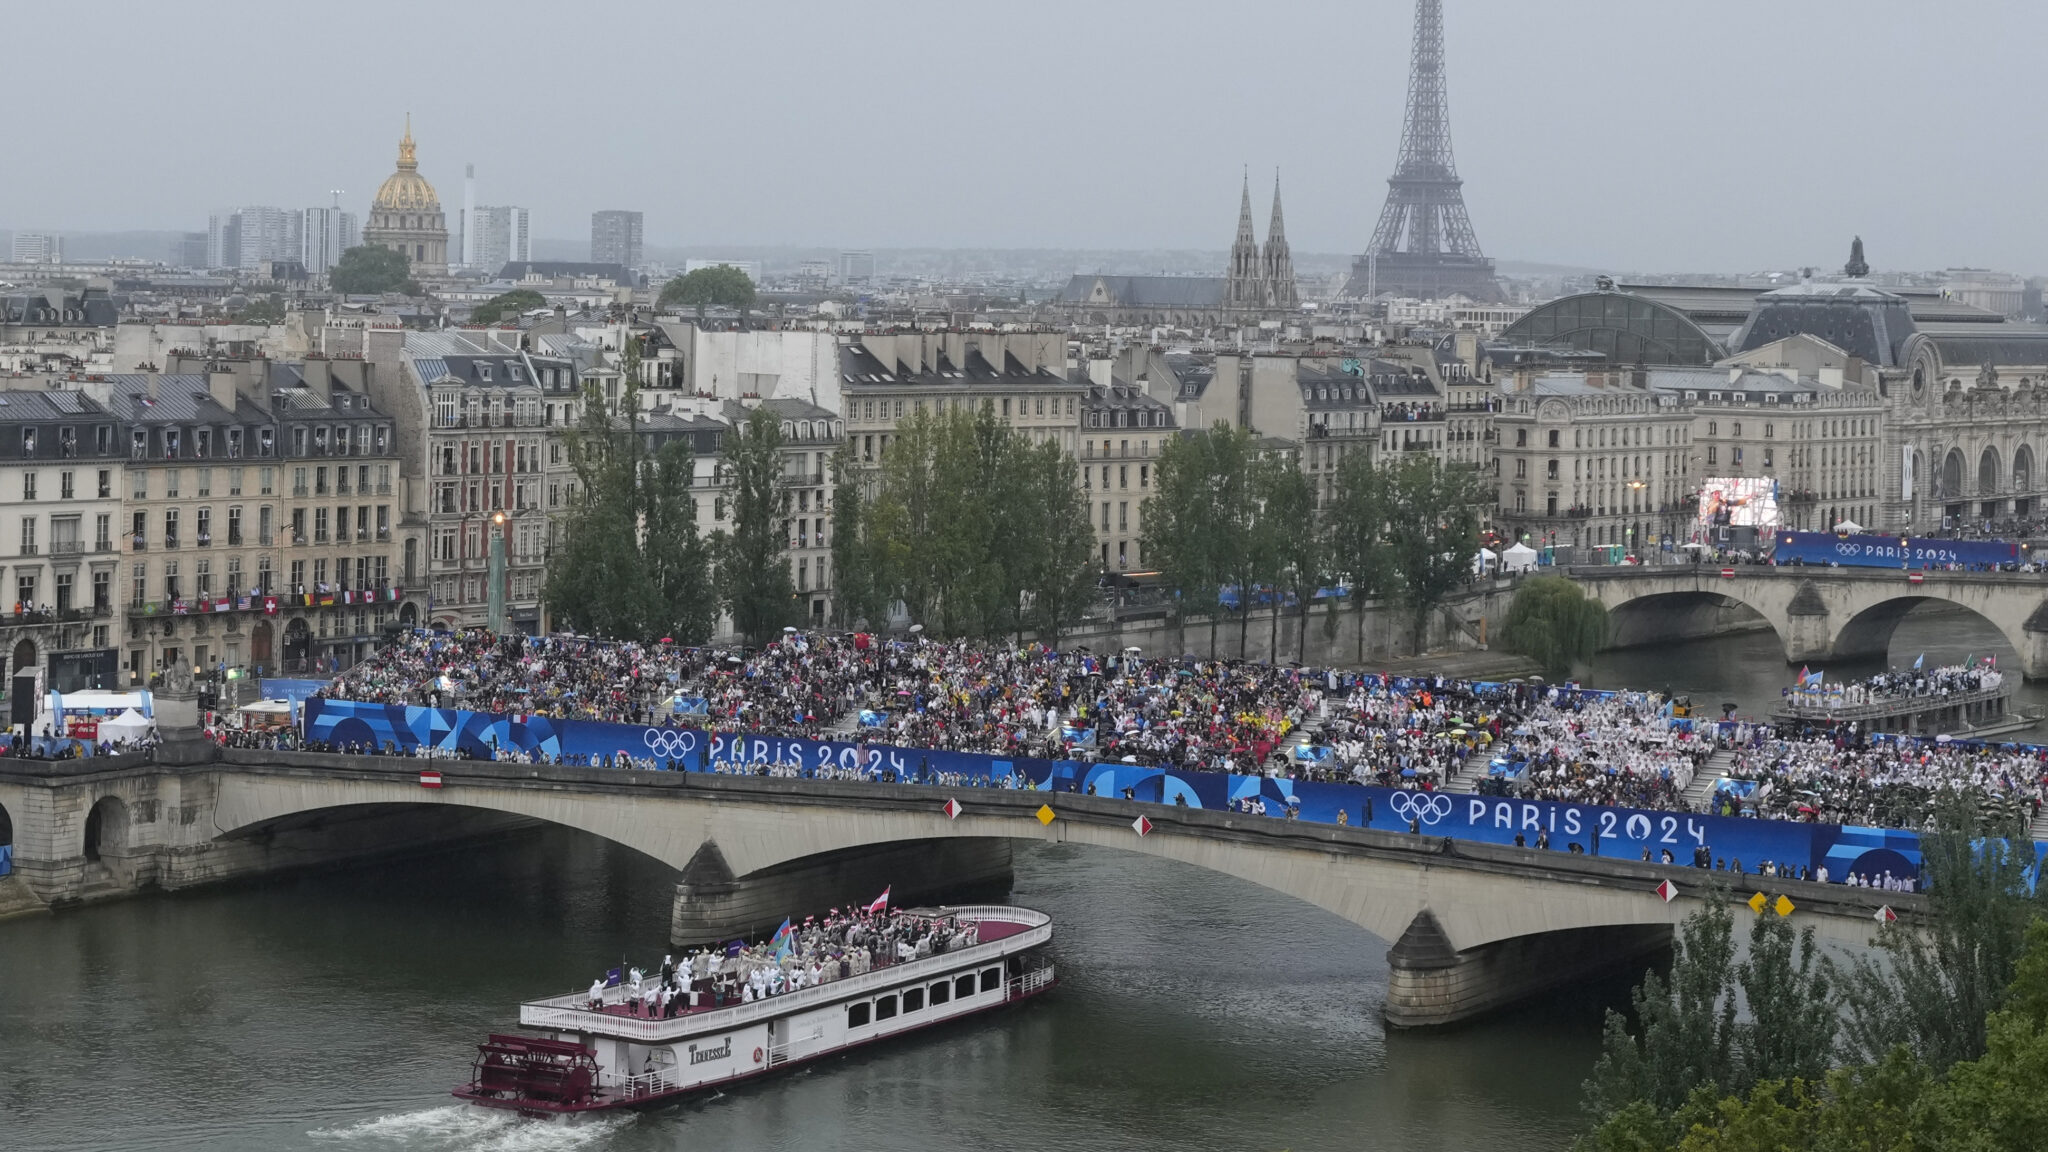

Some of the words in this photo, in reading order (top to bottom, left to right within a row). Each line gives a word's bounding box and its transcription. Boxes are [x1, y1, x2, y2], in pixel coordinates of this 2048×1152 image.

[1916, 548, 1957, 561] 2024
[818, 746, 904, 776] 2024
[1601, 811, 1705, 846] 2024
